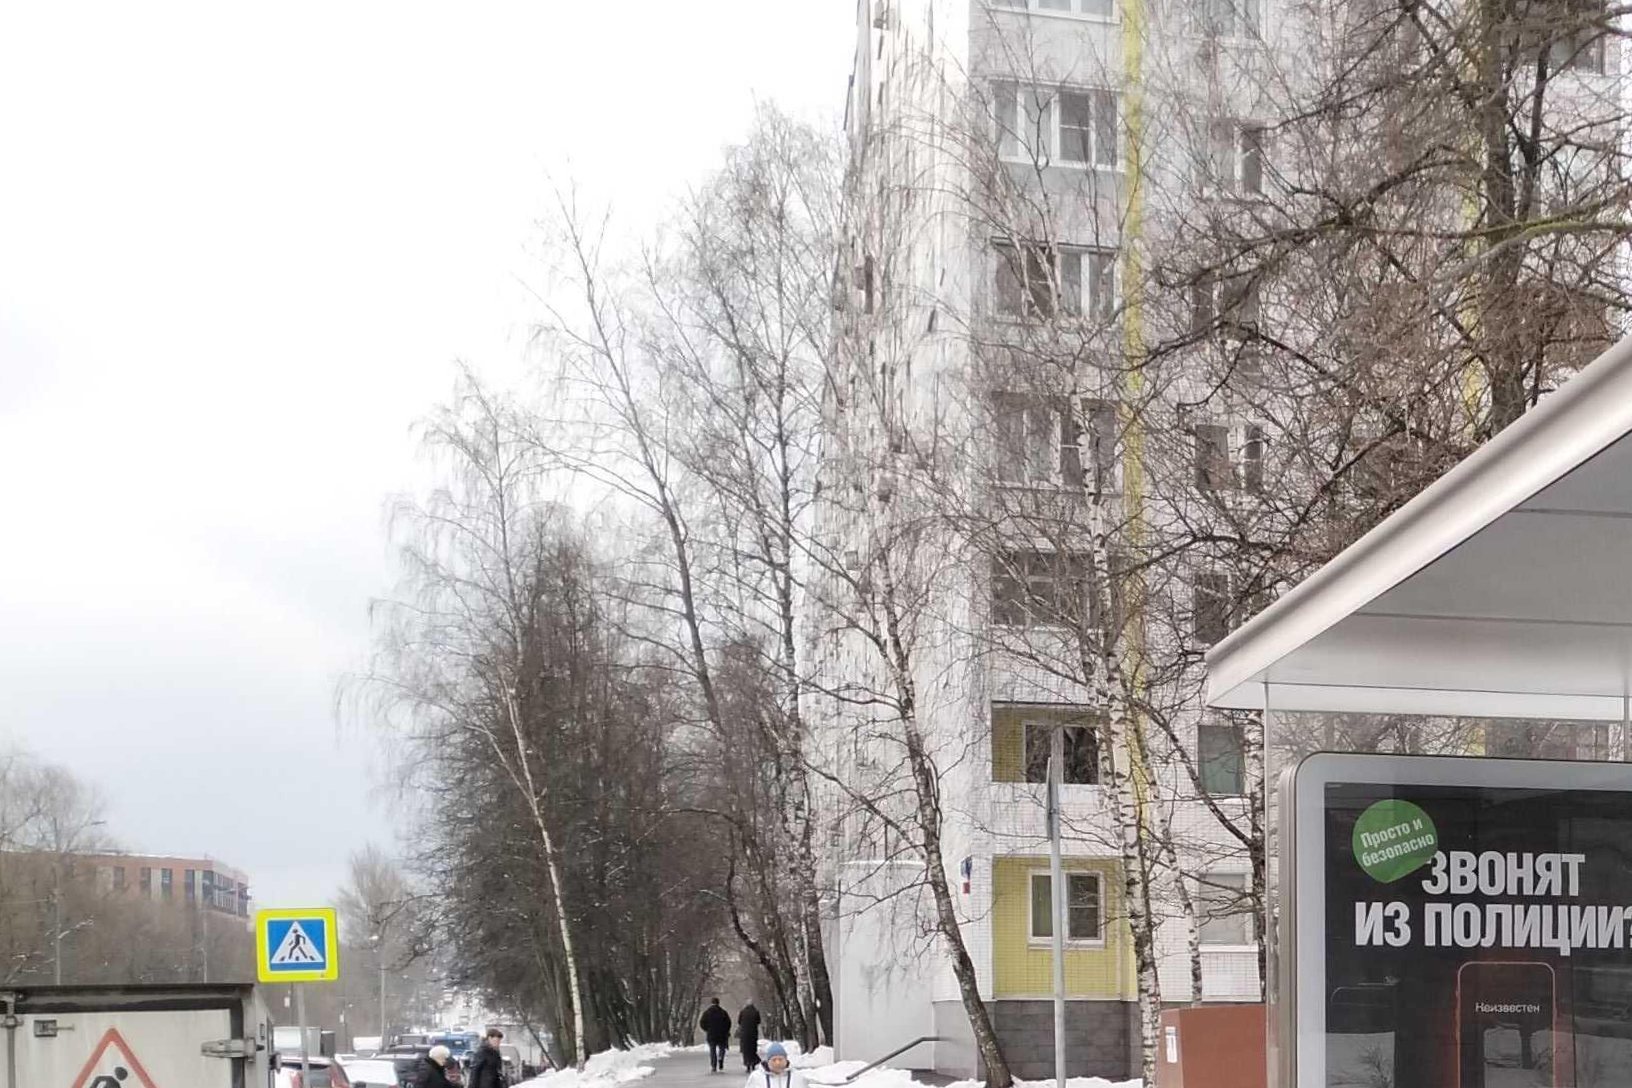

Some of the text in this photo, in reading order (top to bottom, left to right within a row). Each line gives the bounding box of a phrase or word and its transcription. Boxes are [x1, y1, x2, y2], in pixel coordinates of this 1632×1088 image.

[1360, 818, 1424, 849] Просто и
[1362, 834, 1435, 868] безопасно
[1421, 850, 1586, 897] ЗВОНЯТ
[1355, 901, 1412, 947] ИЗ
[1475, 1002, 1540, 1013] Неизвестен
